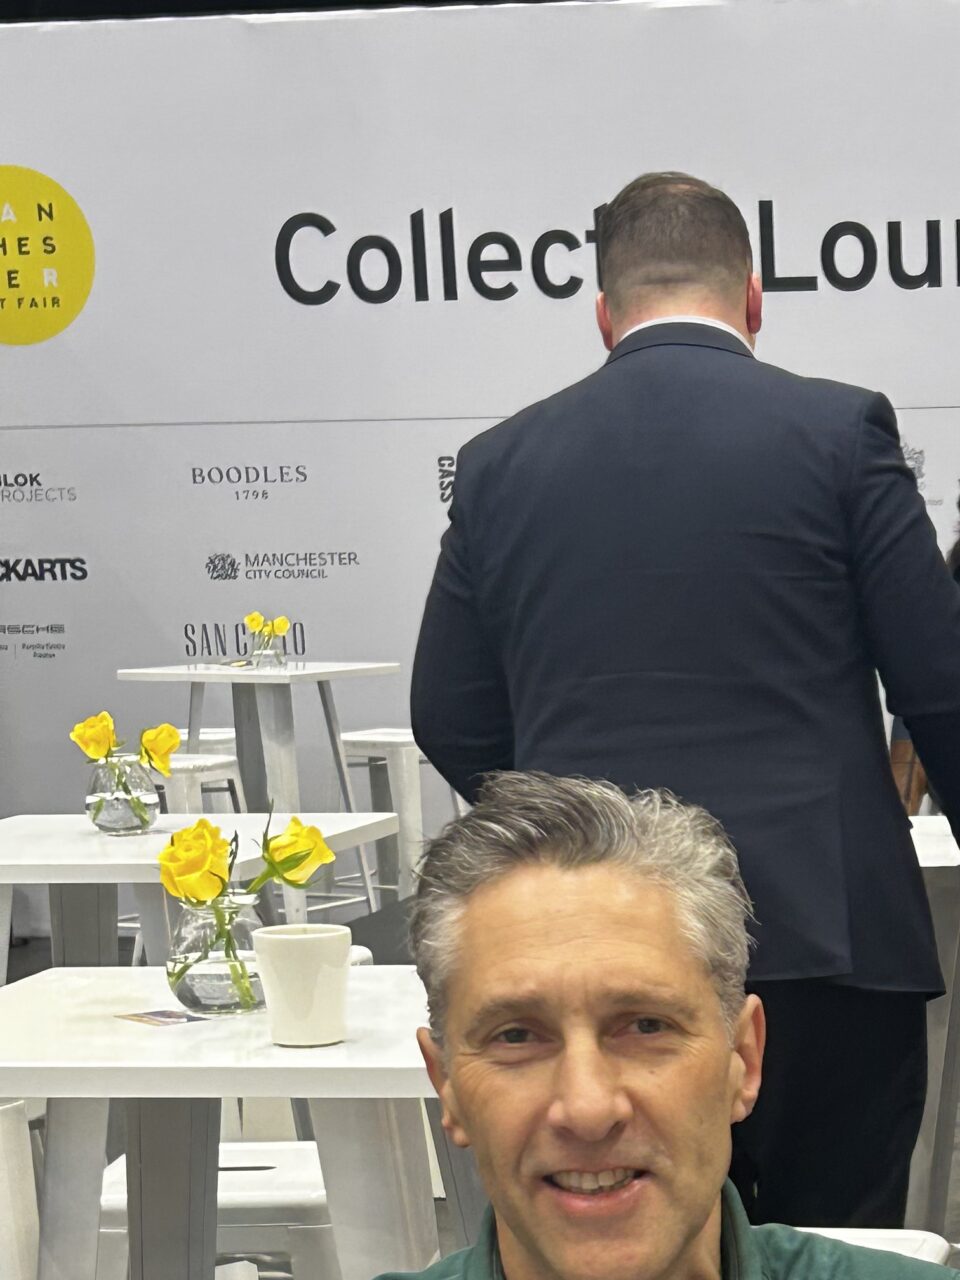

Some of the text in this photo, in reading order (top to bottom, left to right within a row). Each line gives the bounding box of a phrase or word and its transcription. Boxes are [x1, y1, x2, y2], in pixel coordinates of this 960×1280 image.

[17, 296, 61, 309] FAIR
[0, 473, 42, 488] LOK
[191, 465, 308, 485] BOODLES
[245, 552, 360, 567] MANCHESTER
[245, 568, 328, 580] CITY COUNCIL
[184, 622, 306, 657] SAN CLO
